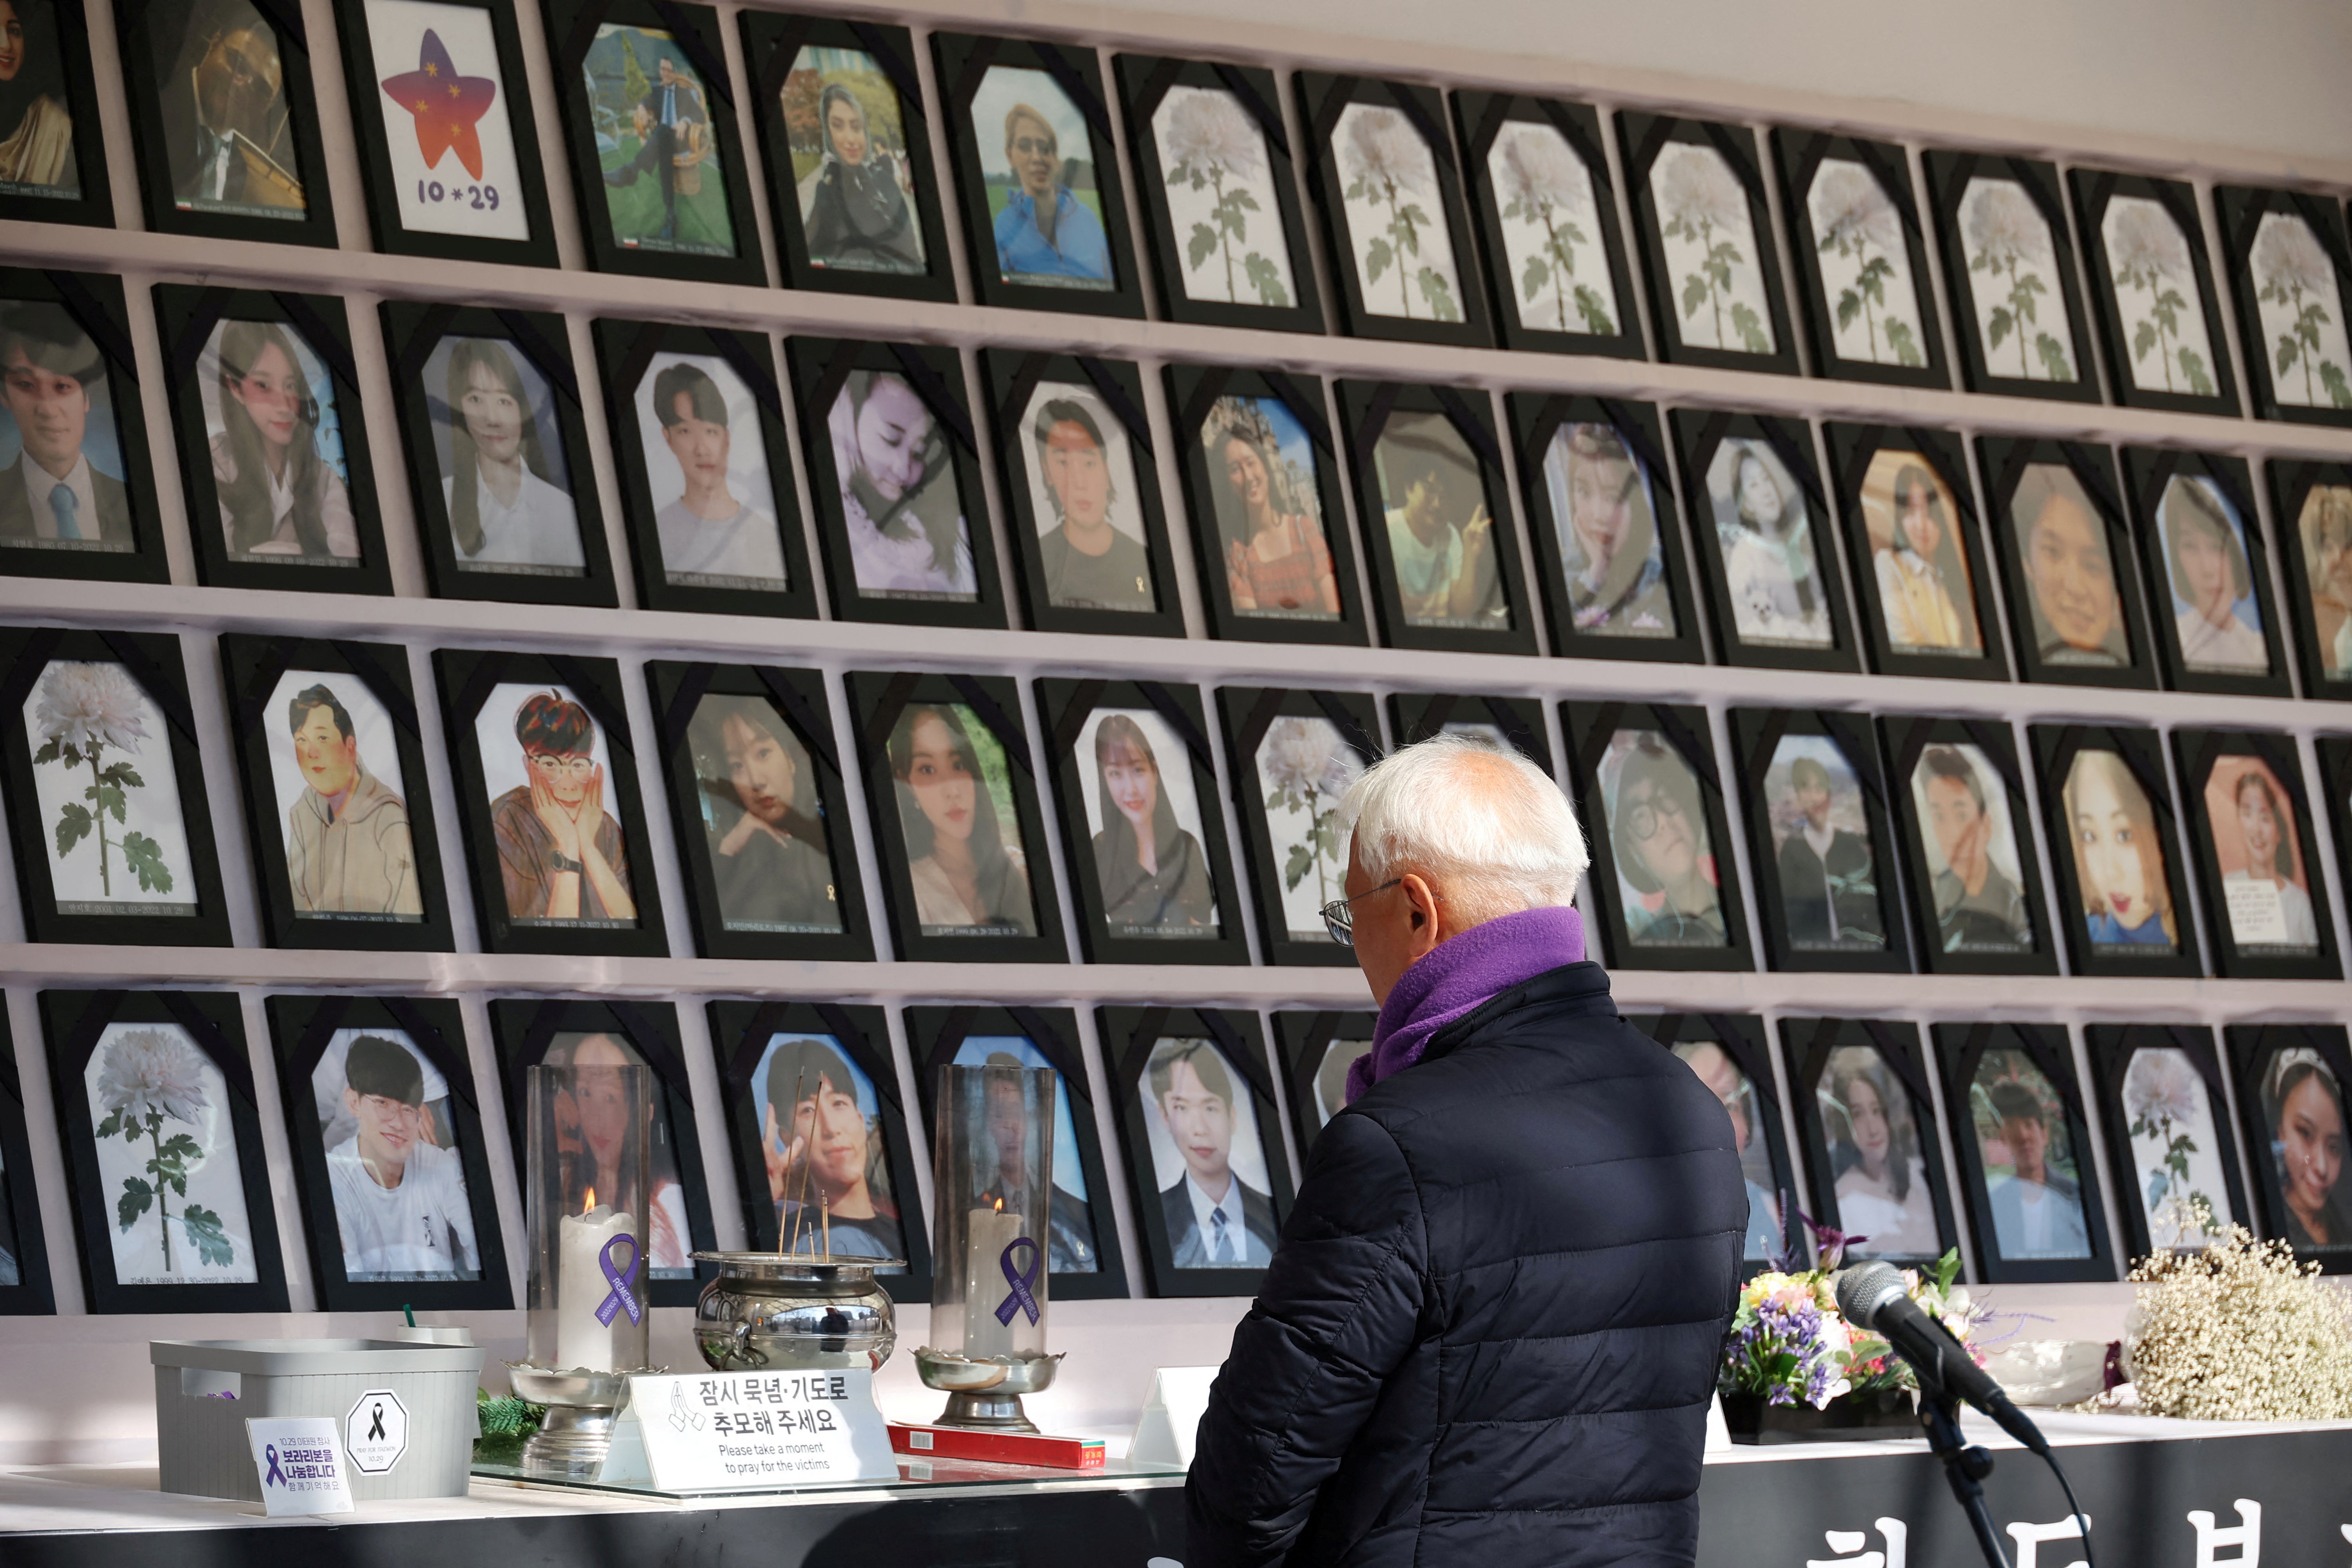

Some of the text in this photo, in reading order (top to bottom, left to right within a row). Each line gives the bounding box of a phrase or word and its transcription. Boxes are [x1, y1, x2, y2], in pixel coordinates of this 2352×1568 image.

[612, 1277, 639, 1321] REMEMBER
[1013, 1279, 1037, 1321] REMEMBER
[601, 1297, 618, 1320] 20221029
[700, 1379, 739, 1406] 잠시
[714, 1409, 837, 1437] 추모해 주세요
[279, 1436, 330, 1446] 10.29 이태원 참사
[718, 1442, 825, 1456] Please take a moment
[282, 1449, 334, 1463] 보라리본을
[368, 1455, 384, 1464] 10.29
[285, 1465, 336, 1479] 나눔합니다
[725, 1458, 830, 1476] to pray for the victims
